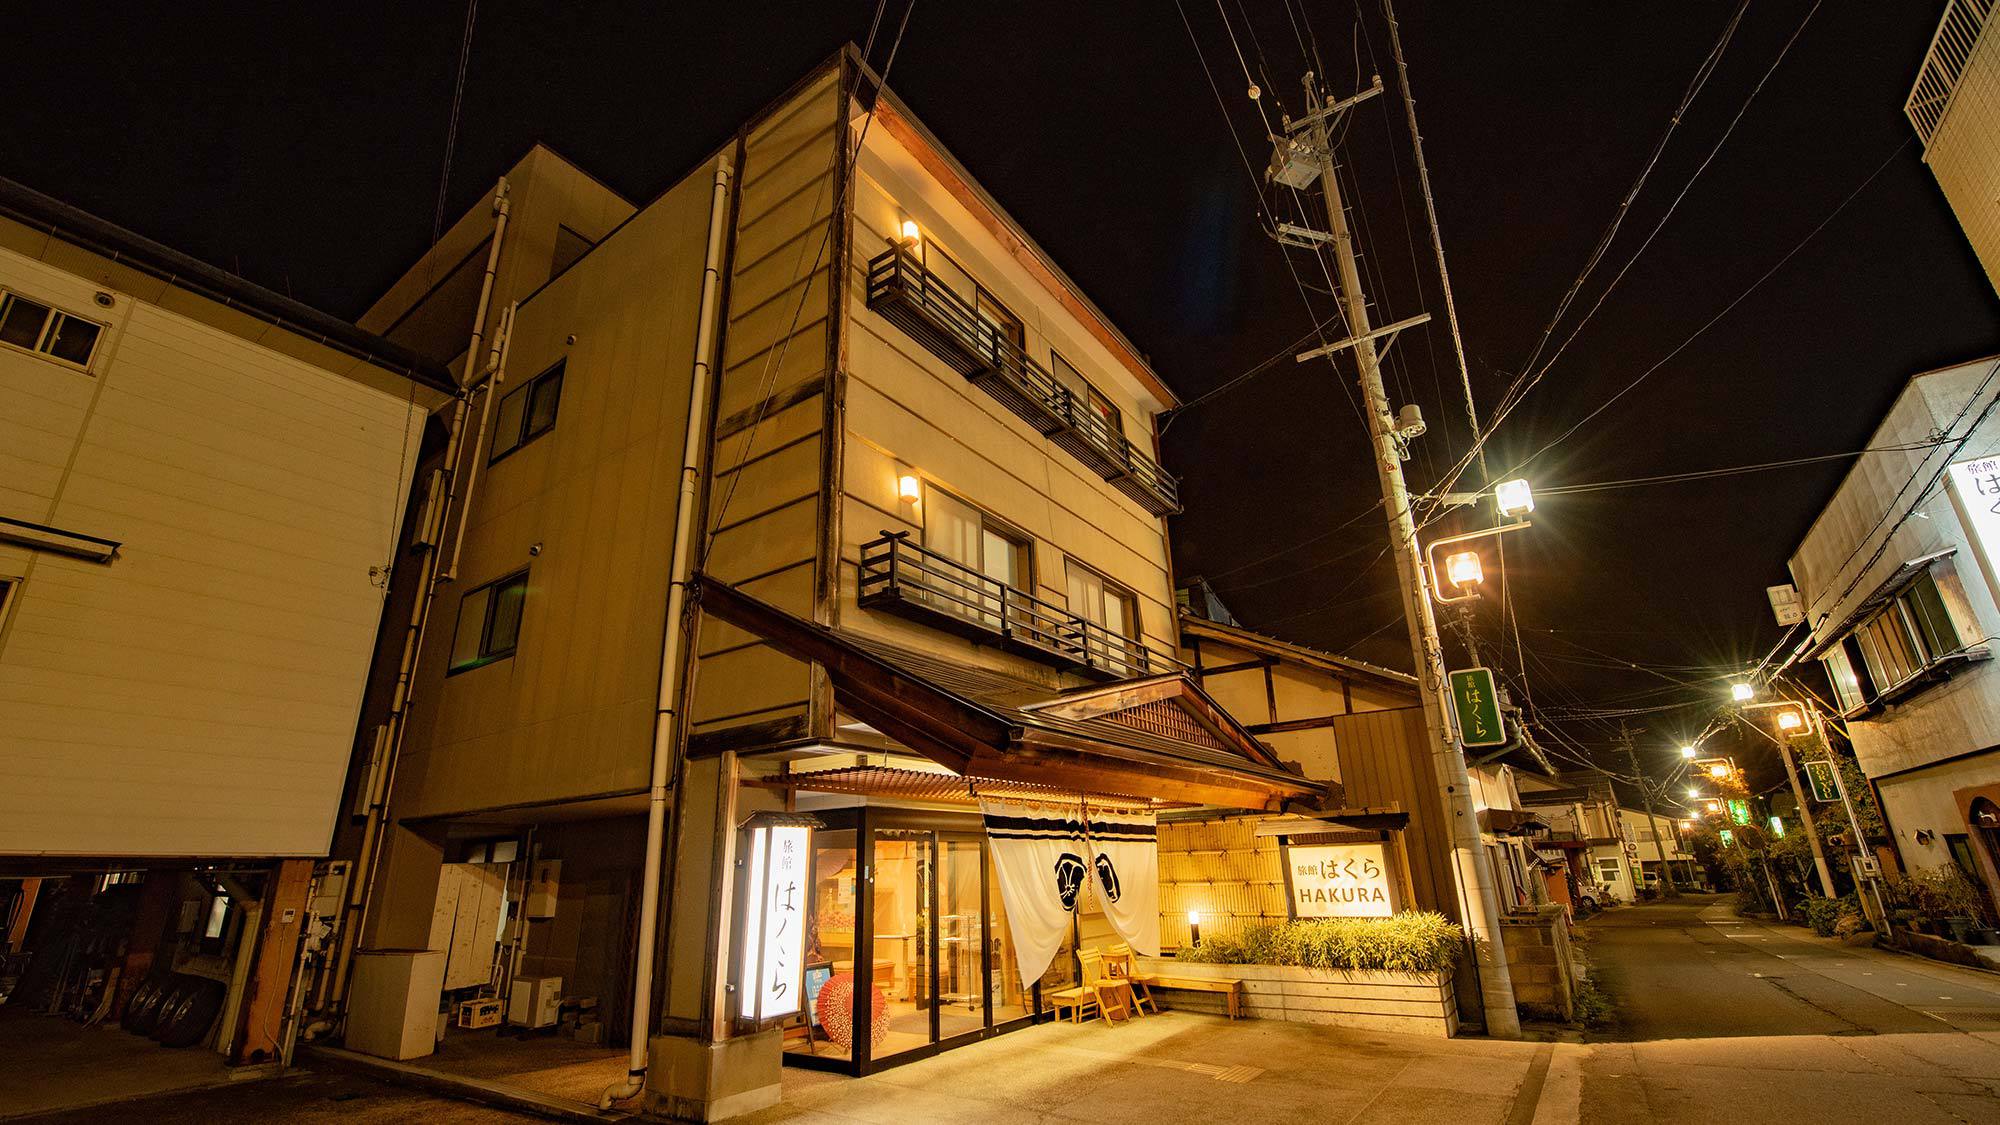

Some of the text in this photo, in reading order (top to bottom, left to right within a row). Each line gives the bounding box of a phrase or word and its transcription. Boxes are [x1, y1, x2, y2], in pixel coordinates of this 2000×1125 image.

[1466, 689, 1486, 737] はくら
[1320, 858, 1380, 879] はくら
[1300, 887, 1386, 903] HAKURA
